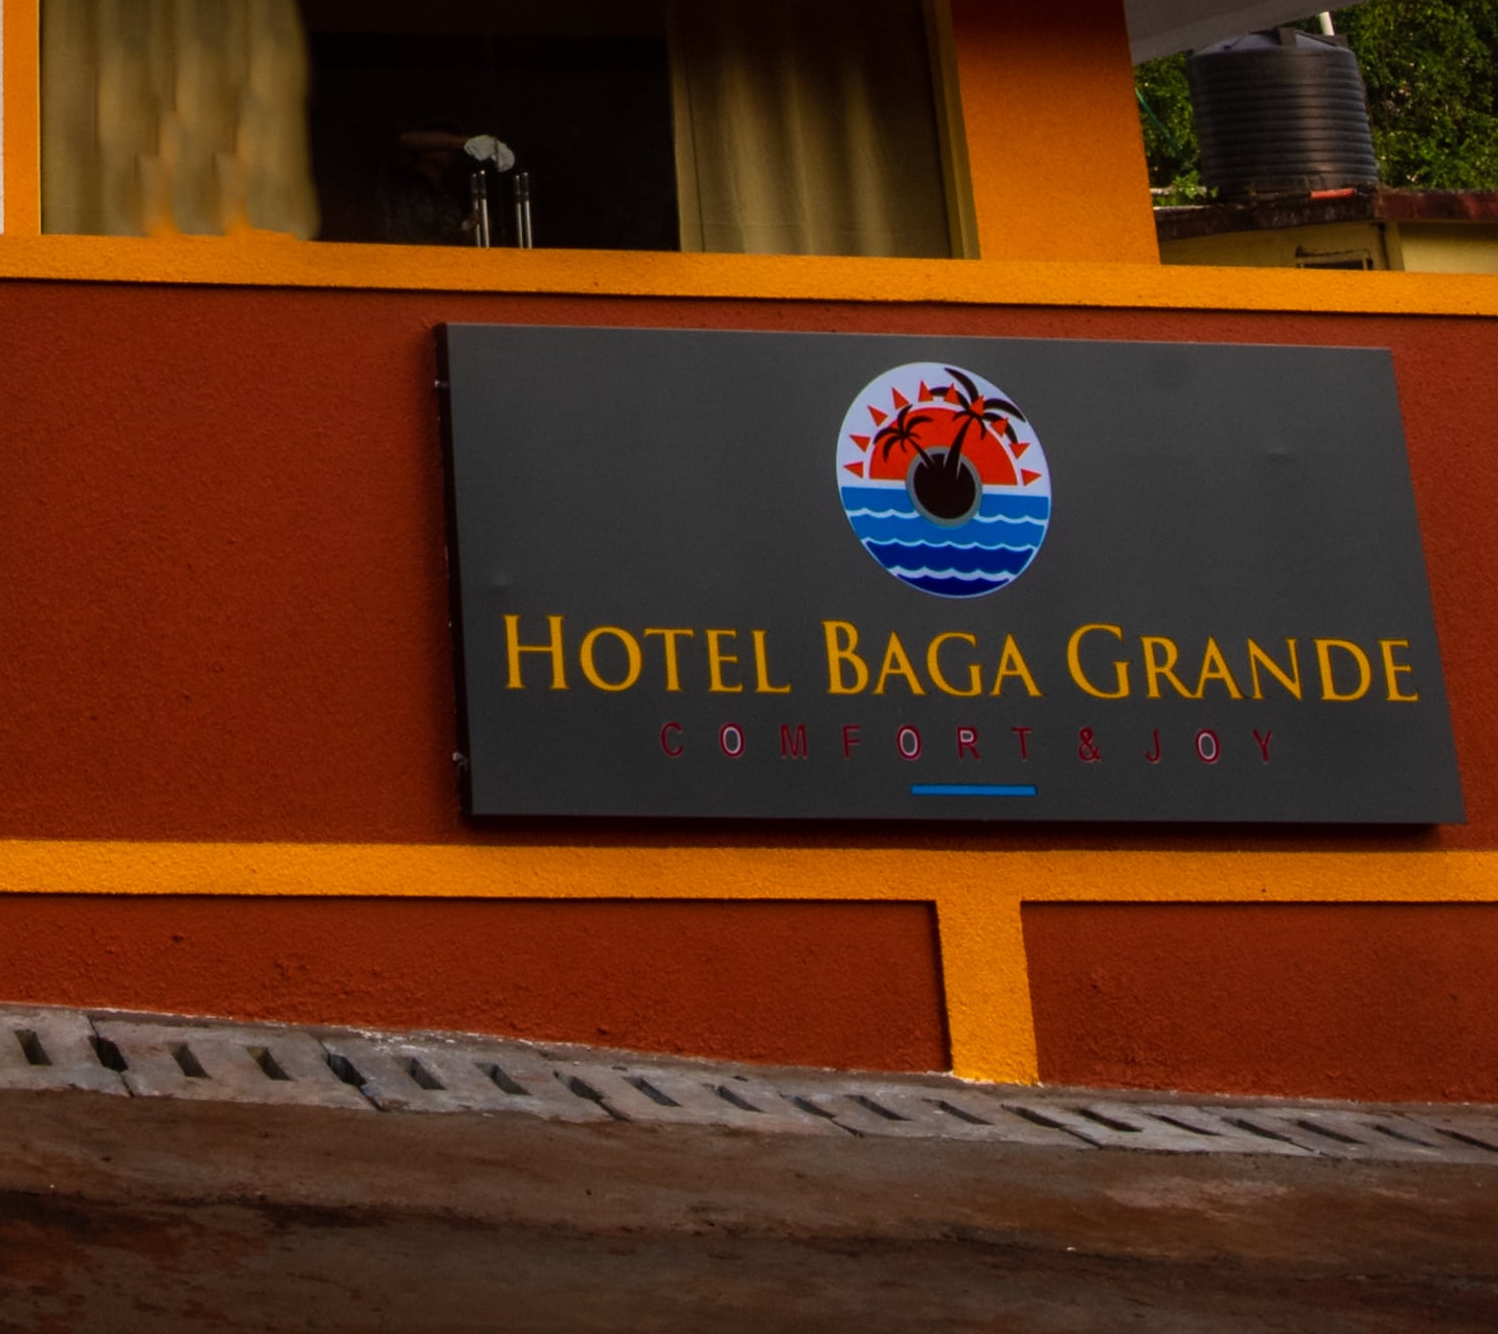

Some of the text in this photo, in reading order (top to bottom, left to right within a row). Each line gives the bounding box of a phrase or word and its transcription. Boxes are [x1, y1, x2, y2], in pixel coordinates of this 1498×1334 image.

[503, 613, 1420, 703] HOTEL BAGA GRANDE
[659, 720, 1273, 765] COMFORT & JOY
